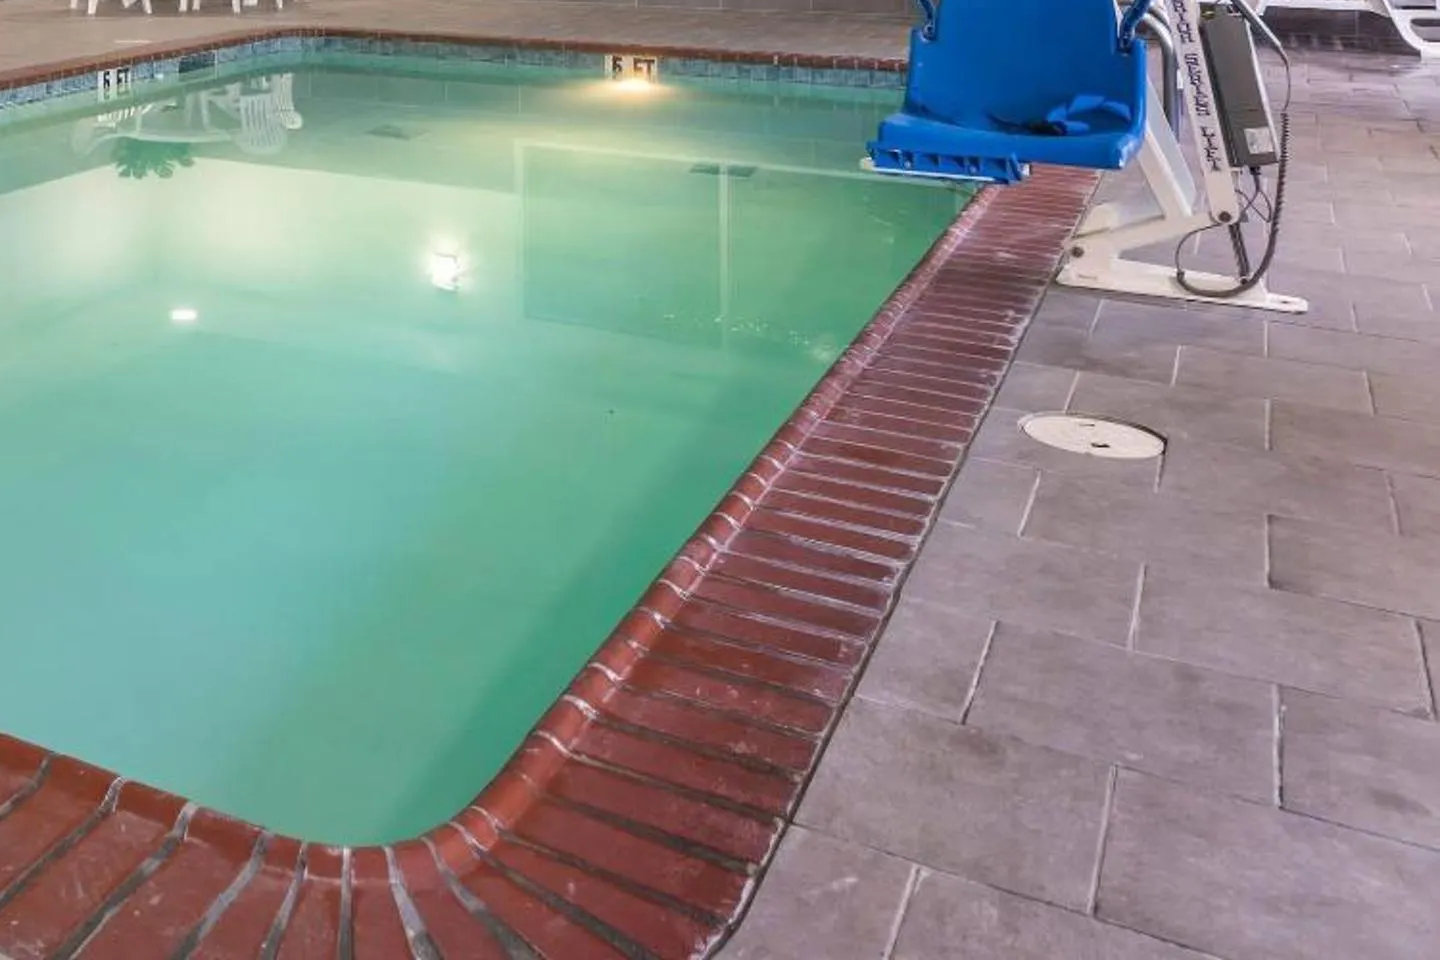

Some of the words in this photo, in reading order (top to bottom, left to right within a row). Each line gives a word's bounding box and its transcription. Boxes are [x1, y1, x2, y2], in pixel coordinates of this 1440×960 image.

[633, 56, 656, 75] FT
[116, 66, 129, 85] FT
[1184, 53, 1210, 116] SERIES
[1200, 126, 1221, 171] LIFT
